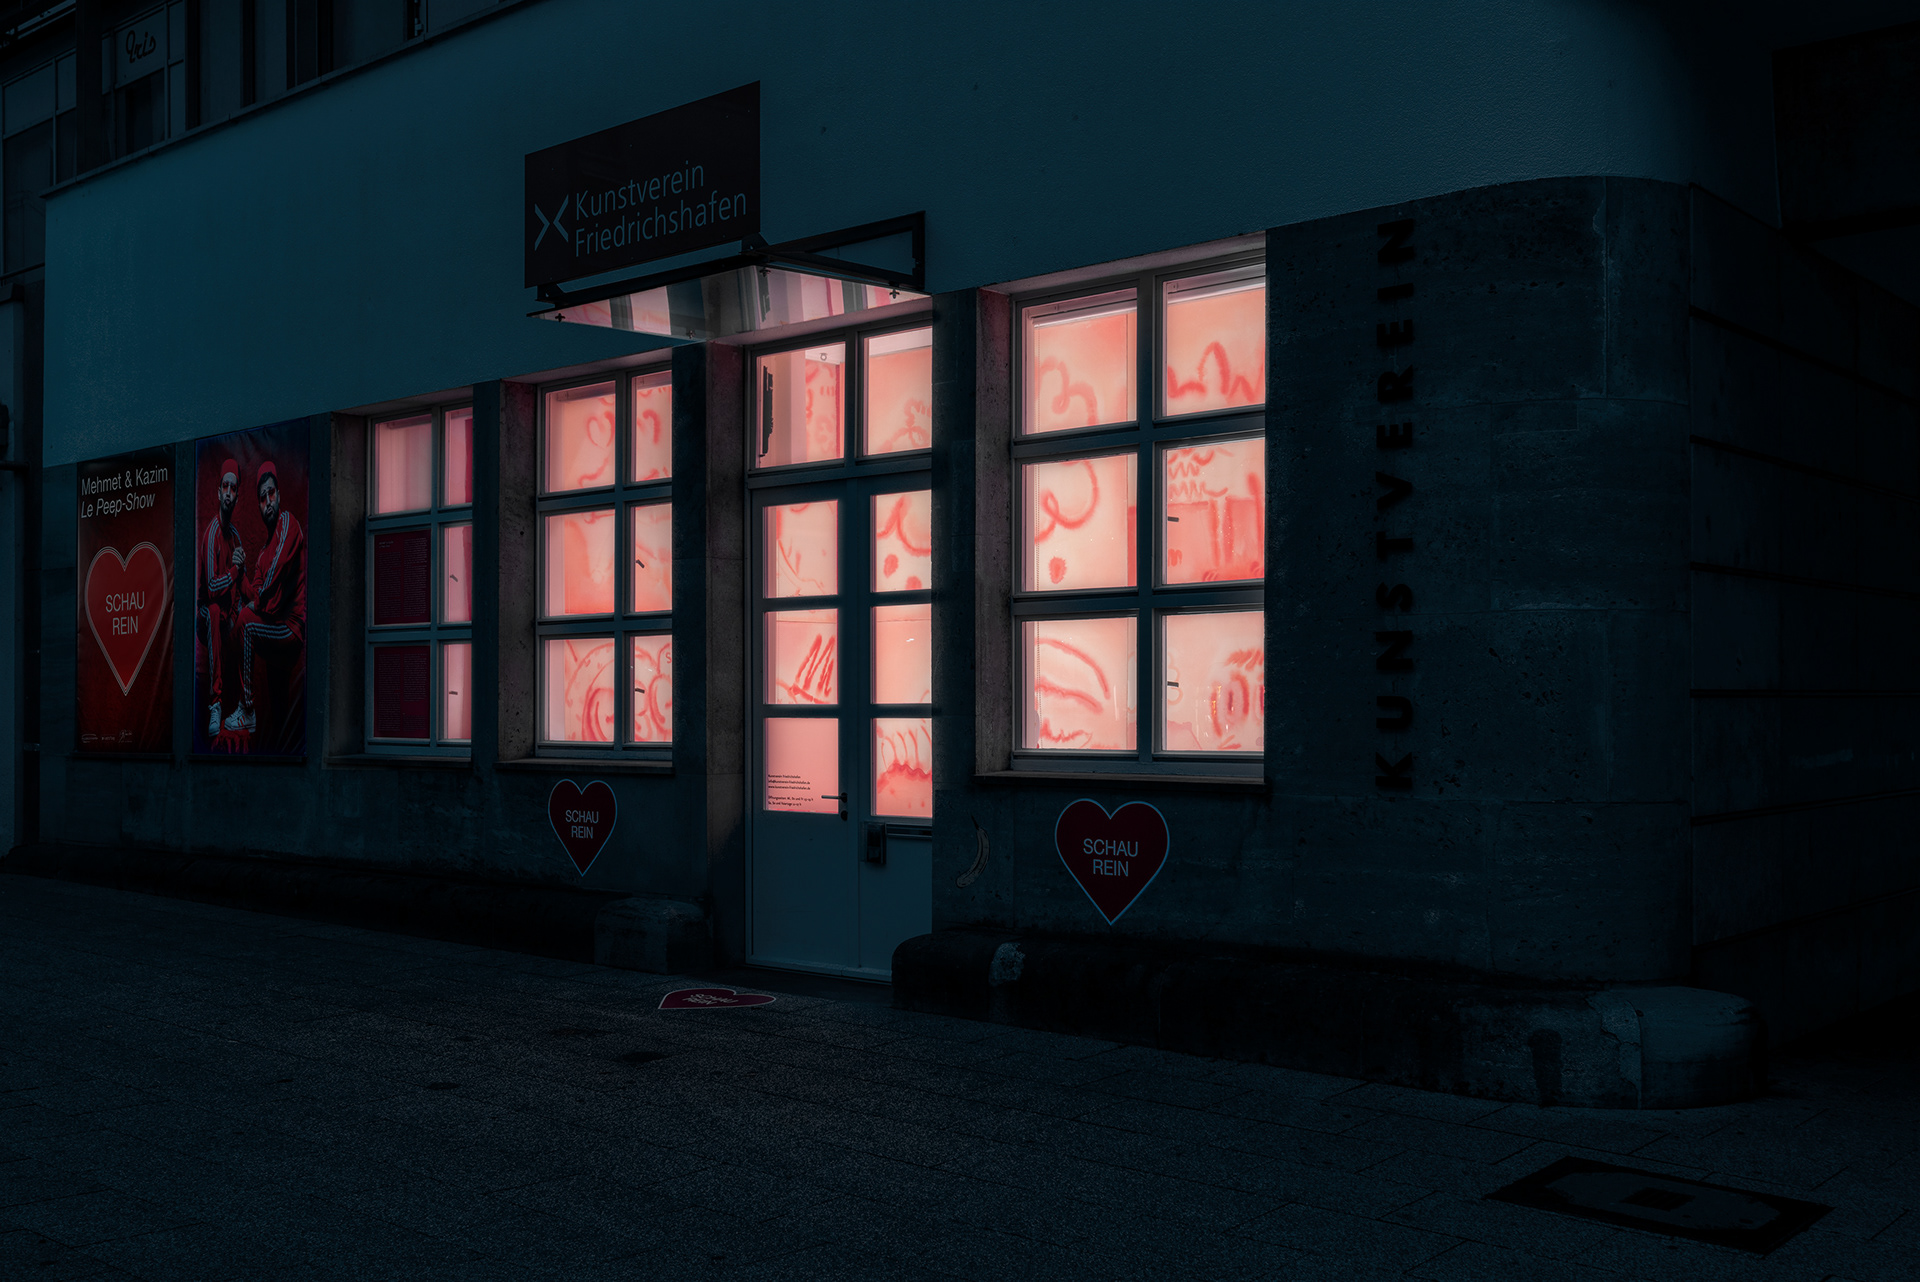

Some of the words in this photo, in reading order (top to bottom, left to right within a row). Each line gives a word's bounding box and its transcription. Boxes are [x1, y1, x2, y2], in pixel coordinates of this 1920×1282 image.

[575, 159, 704, 221] Kunstverein
[575, 189, 748, 258] Friedrichshafen
[81, 472, 122, 496] Mehmet
[124, 469, 133, 488] &
[135, 465, 169, 486] Kazim
[80, 501, 94, 519] Le
[95, 492, 156, 518] Peep-Show
[1375, 218, 1414, 788] KUNSTVEREIN
[105, 590, 145, 613] SCHAU
[112, 615, 139, 636] REIN
[565, 809, 600, 824] SCHAU
[570, 825, 594, 839] REIN
[1082, 837, 1139, 858] SCHAU
[1092, 858, 1129, 877] REIN
